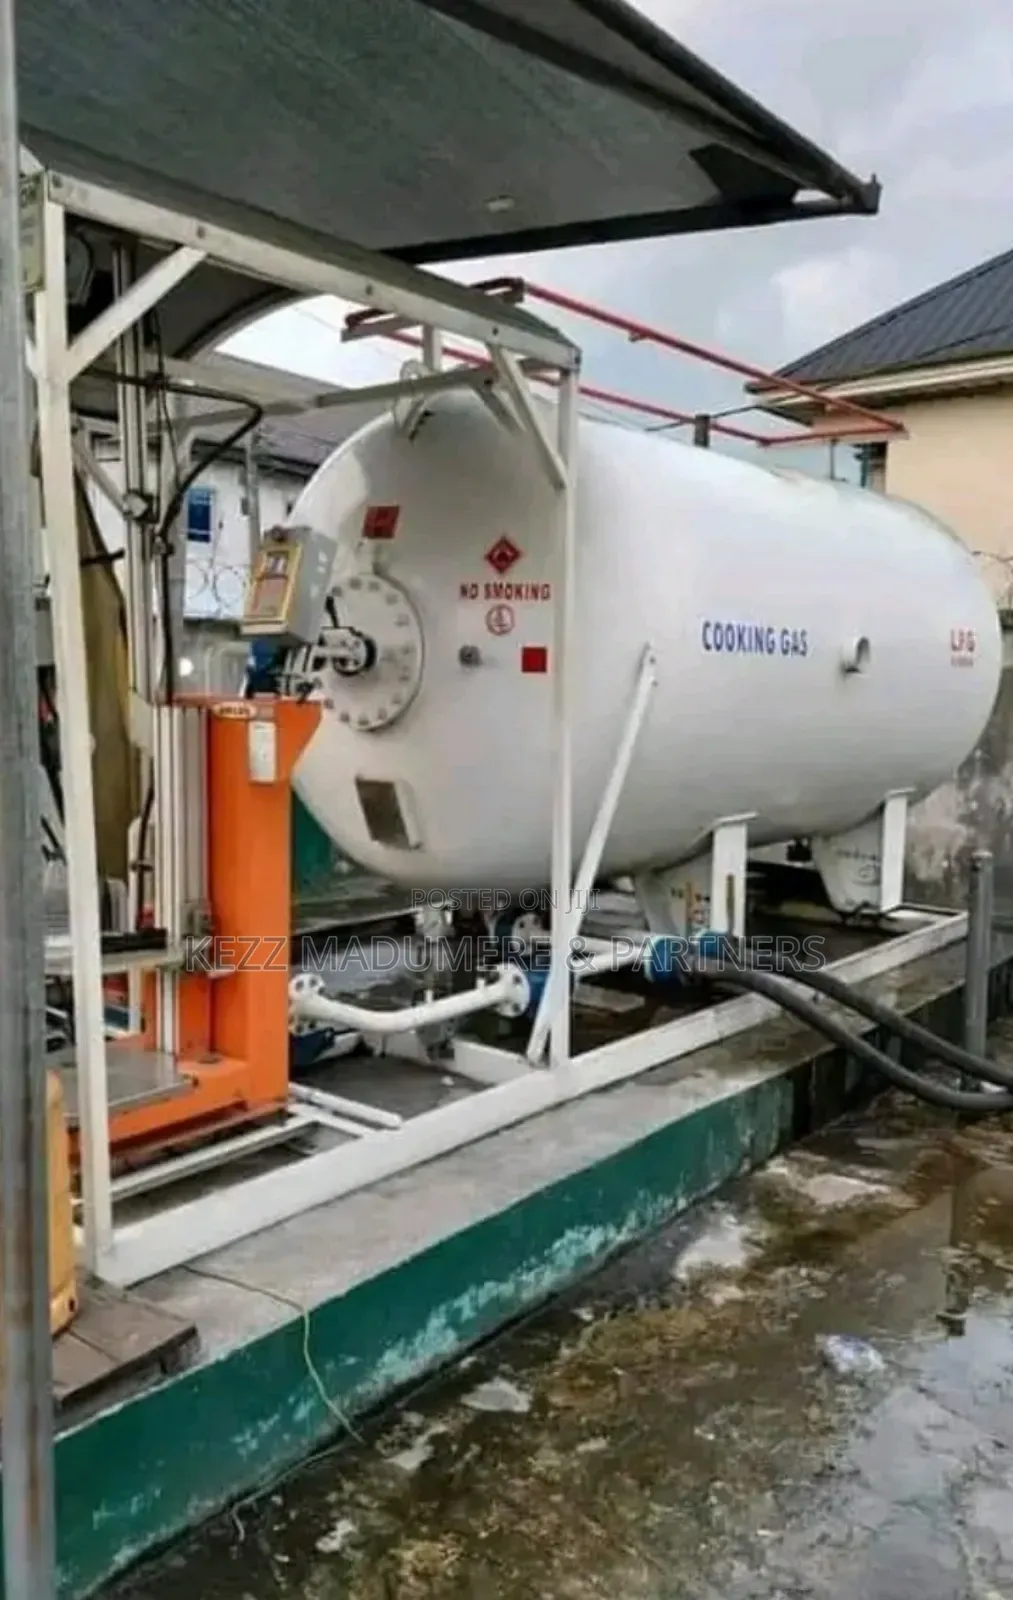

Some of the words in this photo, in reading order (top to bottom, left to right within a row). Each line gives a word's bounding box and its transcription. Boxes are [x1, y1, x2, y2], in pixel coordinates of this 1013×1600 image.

[484, 583, 551, 600] SMOKING
[702, 621, 776, 654] COOKING
[780, 628, 808, 656] GAS
